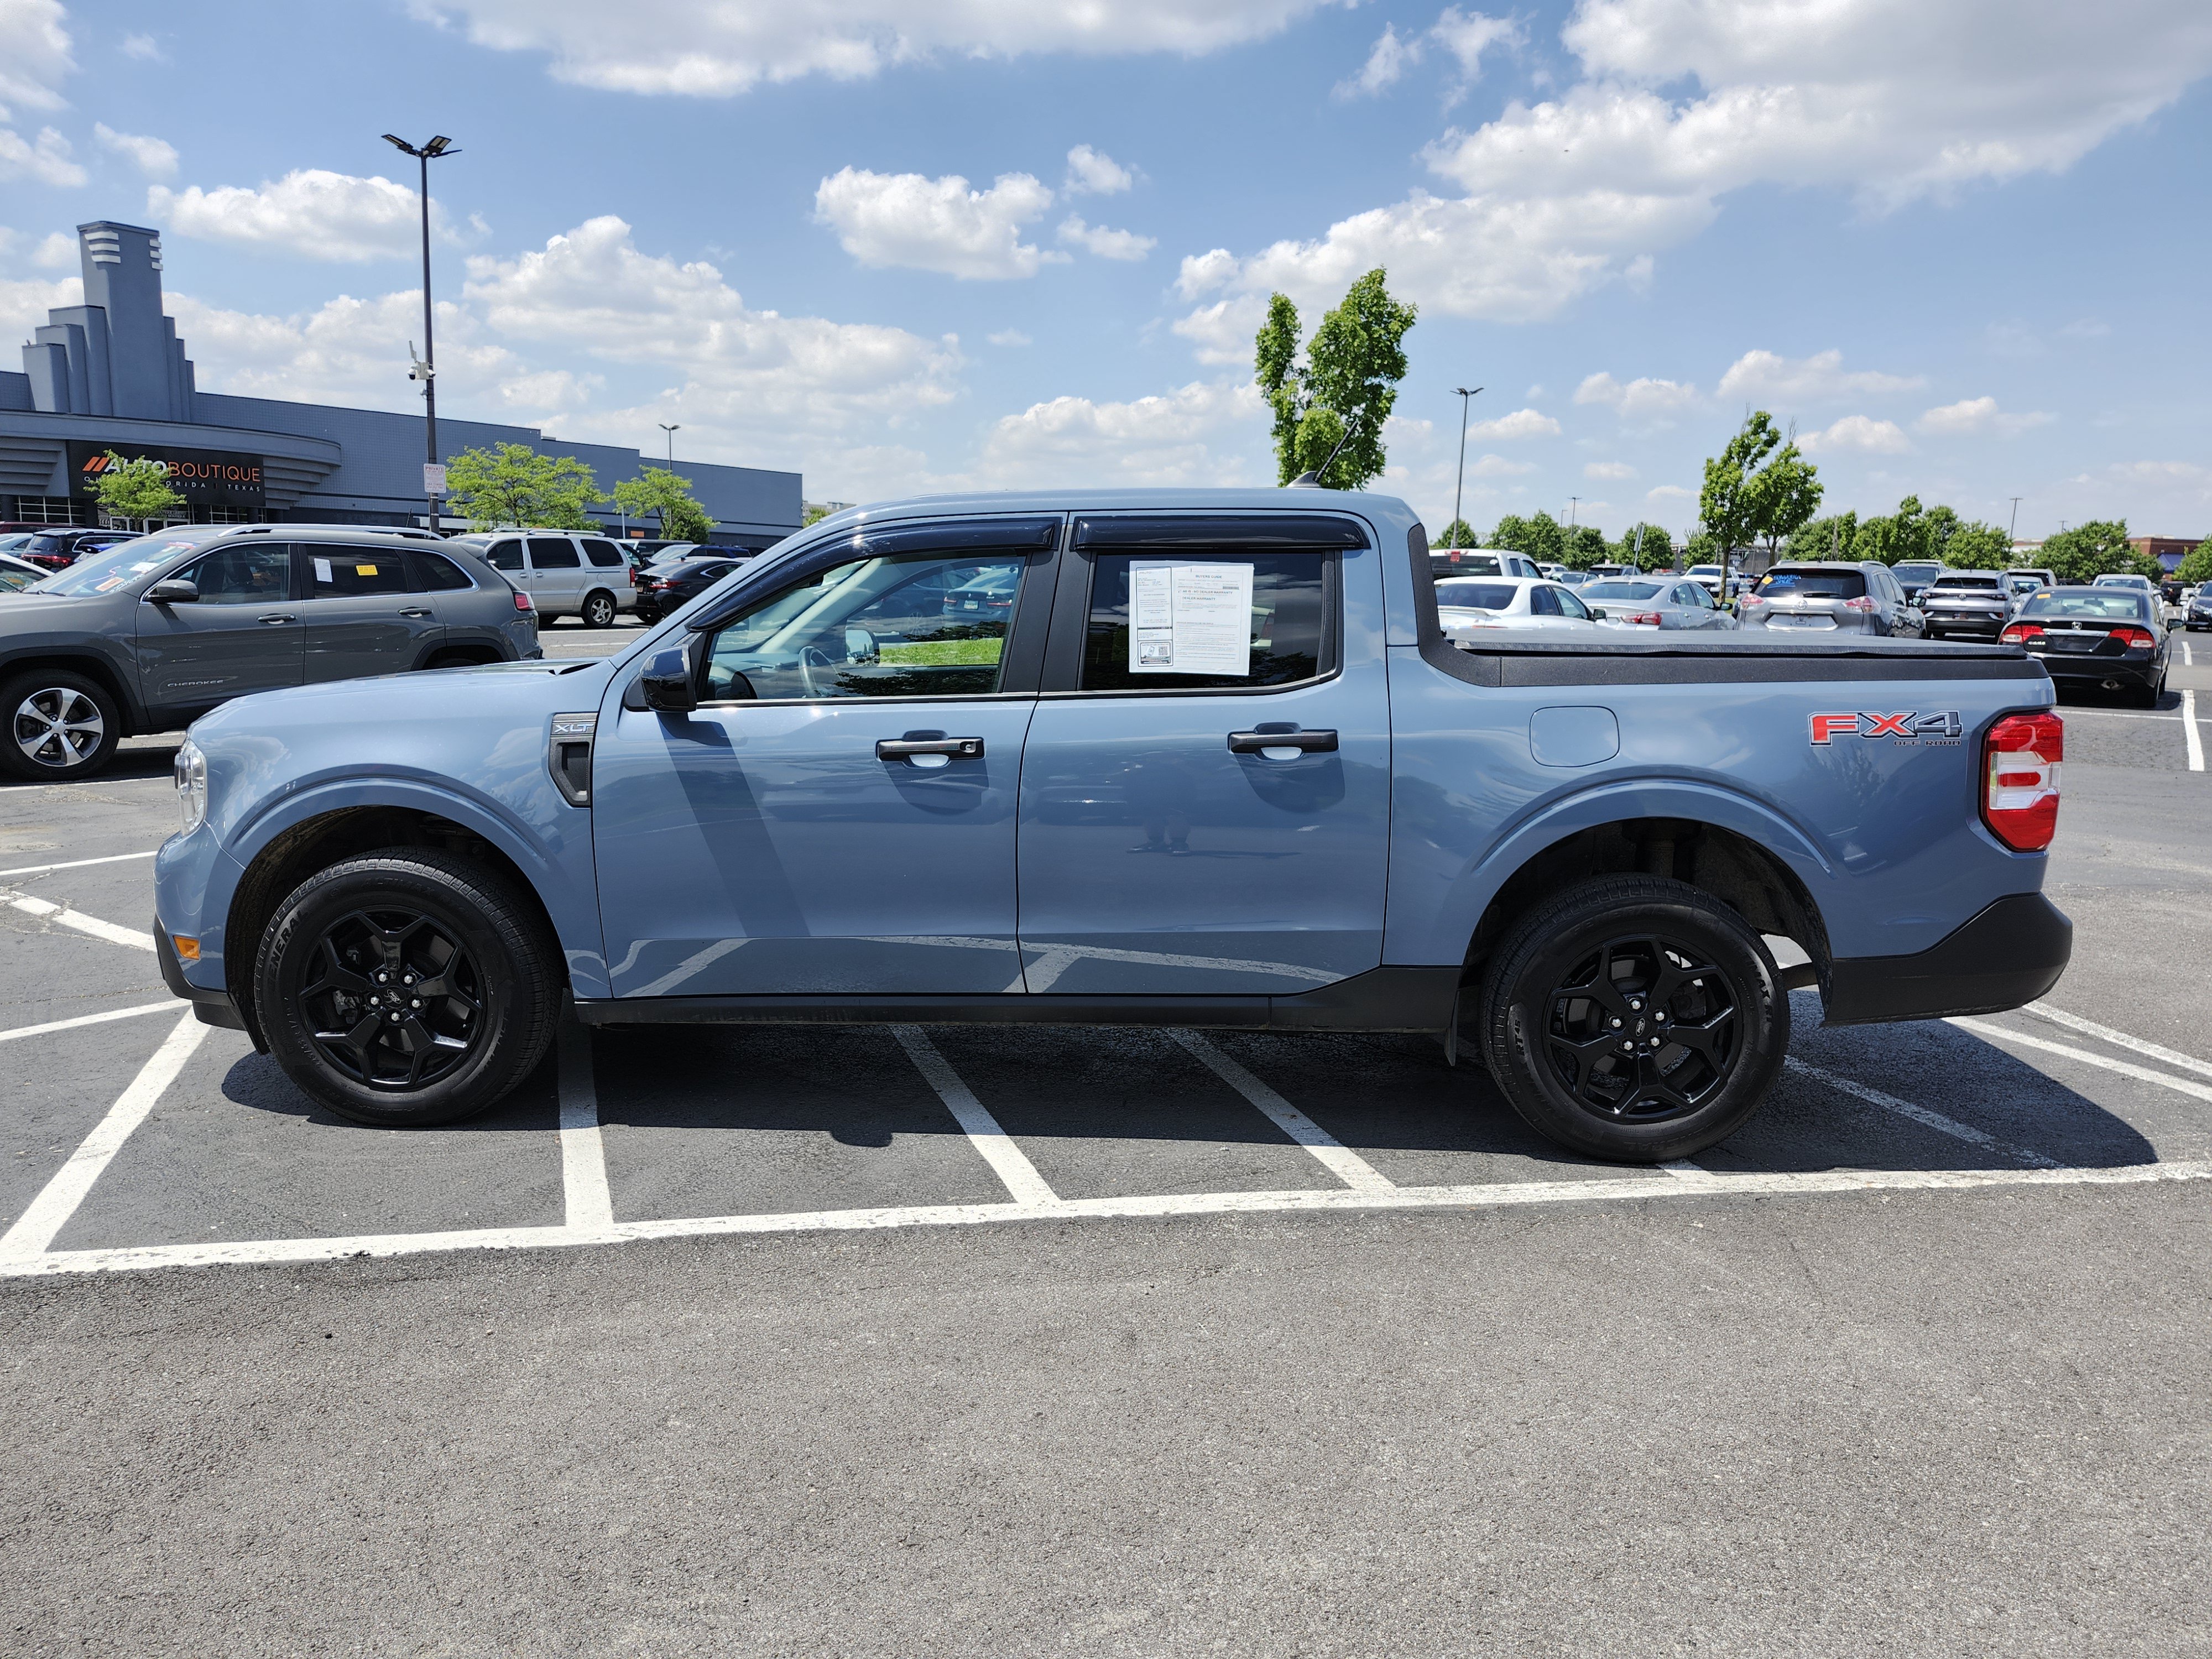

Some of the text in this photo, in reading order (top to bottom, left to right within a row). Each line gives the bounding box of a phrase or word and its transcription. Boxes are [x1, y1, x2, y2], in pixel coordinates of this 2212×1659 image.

[227, 483, 260, 492] TEXAS
[554, 724, 594, 734] XLT
[1808, 711, 1963, 747] FX4
